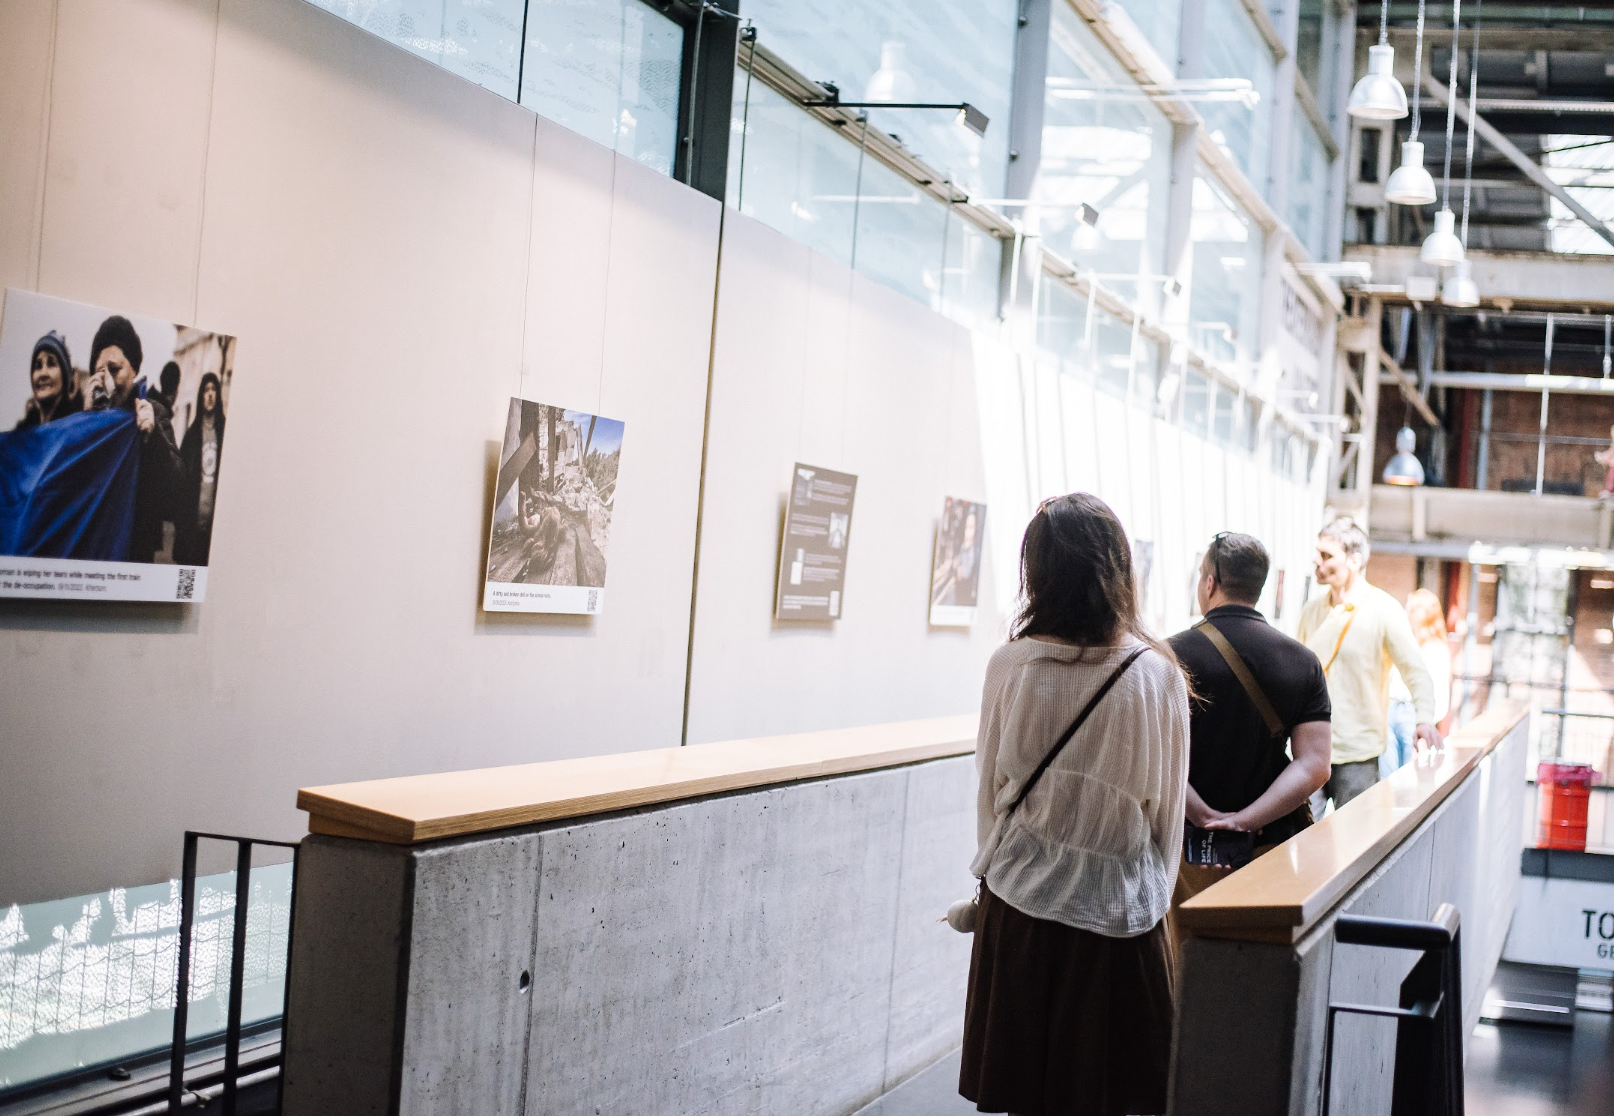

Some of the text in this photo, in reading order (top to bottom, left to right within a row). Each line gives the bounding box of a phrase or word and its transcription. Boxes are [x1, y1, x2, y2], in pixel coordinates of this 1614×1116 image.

[23, 570, 41, 579] wiping
[84, 572, 105, 580] meeting
[107, 572, 116, 580] the
[1201, 839, 1207, 848] OF
[1582, 909, 1614, 940] TO
